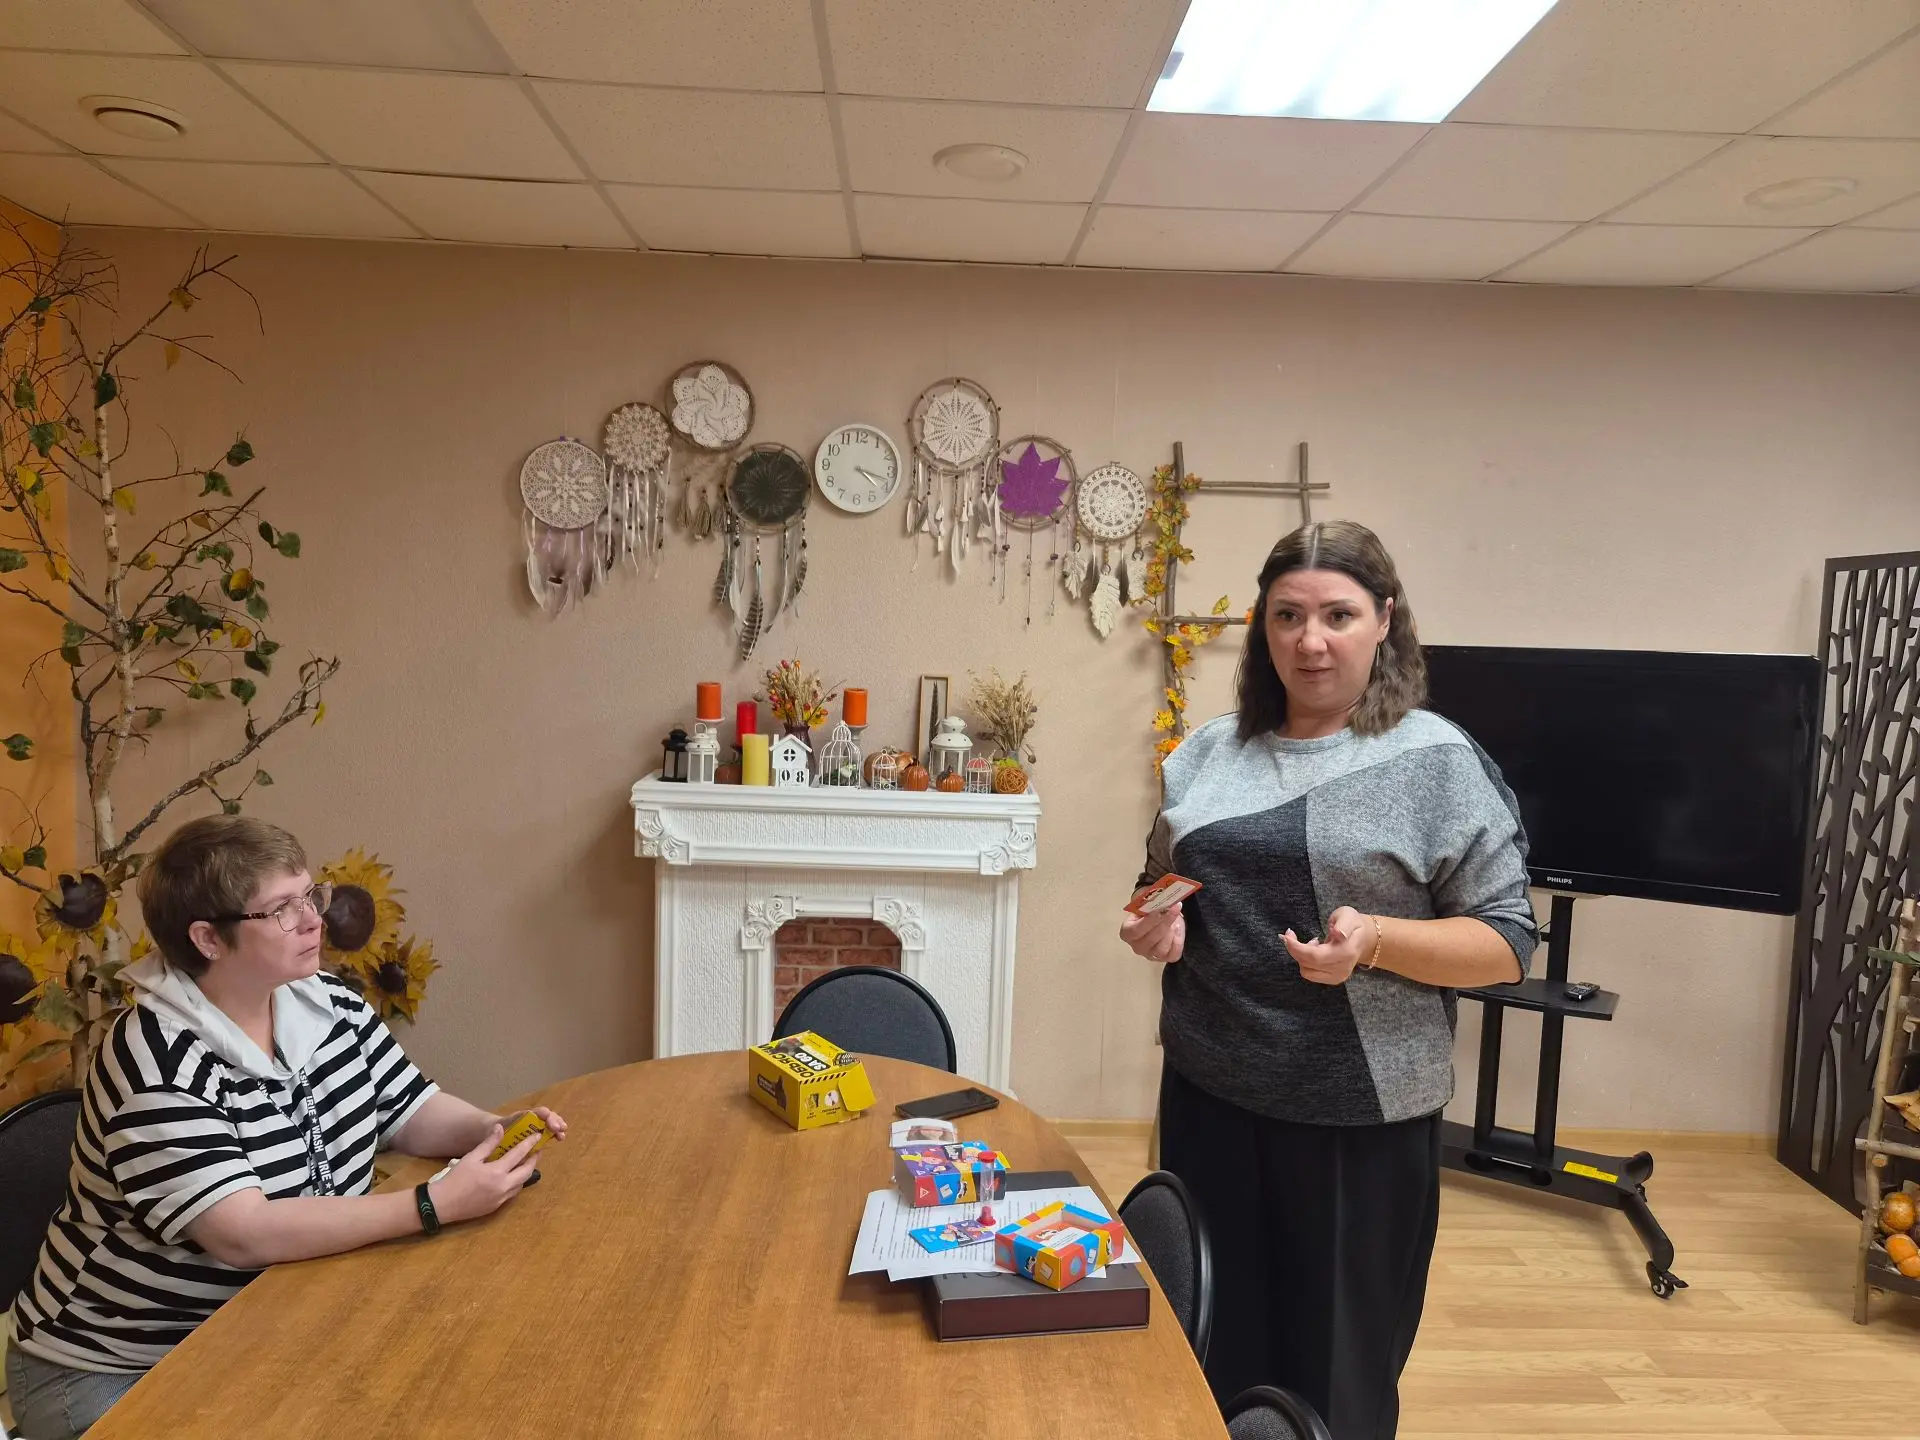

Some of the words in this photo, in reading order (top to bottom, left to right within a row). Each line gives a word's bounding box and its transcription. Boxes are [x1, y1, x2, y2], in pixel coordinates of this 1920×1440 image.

[841, 433, 850, 445] 11
[855, 431, 868, 443] 12
[875, 436, 880, 448] 1
[828, 444, 840, 456] 10
[884, 449, 891, 461] 2
[822, 459, 830, 470] 9
[887, 466, 896, 478] 3
[826, 476, 834, 487] 8
[881, 481, 889, 493] 4
[838, 488, 845, 499] 7
[853, 494, 860, 505] 6
[868, 490, 876, 502] 5
[1547, 876, 1572, 884] PHILIPS
[306, 1096, 316, 1116] IRIE
[312, 1125, 324, 1152] WASH
[318, 1160, 331, 1181] IRIE
